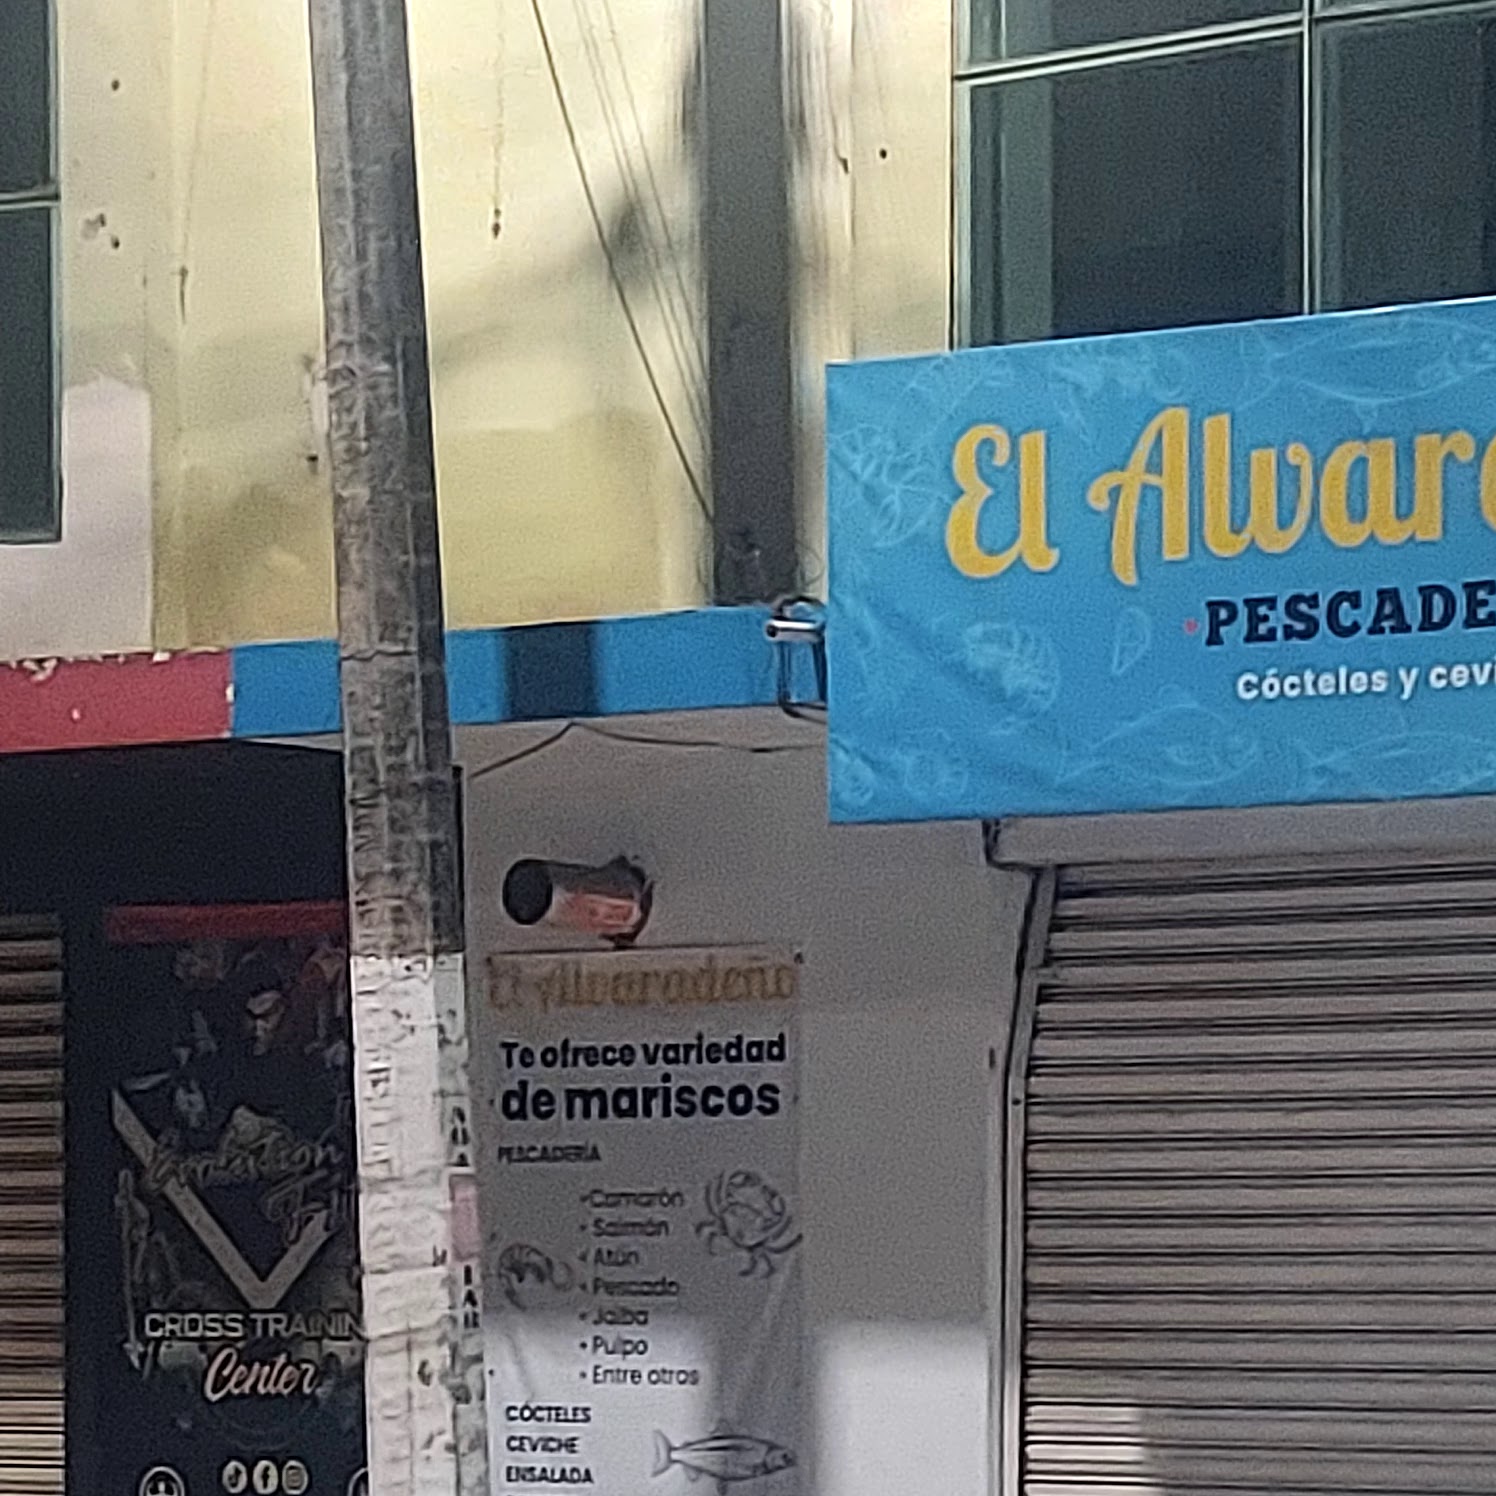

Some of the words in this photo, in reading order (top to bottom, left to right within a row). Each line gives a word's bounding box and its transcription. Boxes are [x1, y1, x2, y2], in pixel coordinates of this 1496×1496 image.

[945, 424, 1058, 579] El
[1236, 662, 1390, 703] Cócteles
[1398, 665, 1419, 703] y
[500, 1040, 536, 1069] Te
[540, 1036, 637, 1069] ofrece
[641, 1031, 787, 1066] variedad
[501, 1080, 557, 1121] de
[564, 1072, 781, 1120] mariscos
[144, 1311, 244, 1339] CROSS
[251, 1310, 364, 1339] TRAININ
[592, 1336, 649, 1361] Pulpo
[203, 1346, 319, 1403] Center
[592, 1366, 642, 1386] Entre
[647, 1366, 700, 1387] otros
[505, 1402, 592, 1424] CÓCTELES
[505, 1436, 580, 1455] CEVICHE
[505, 1466, 594, 1485] ENSALADA
